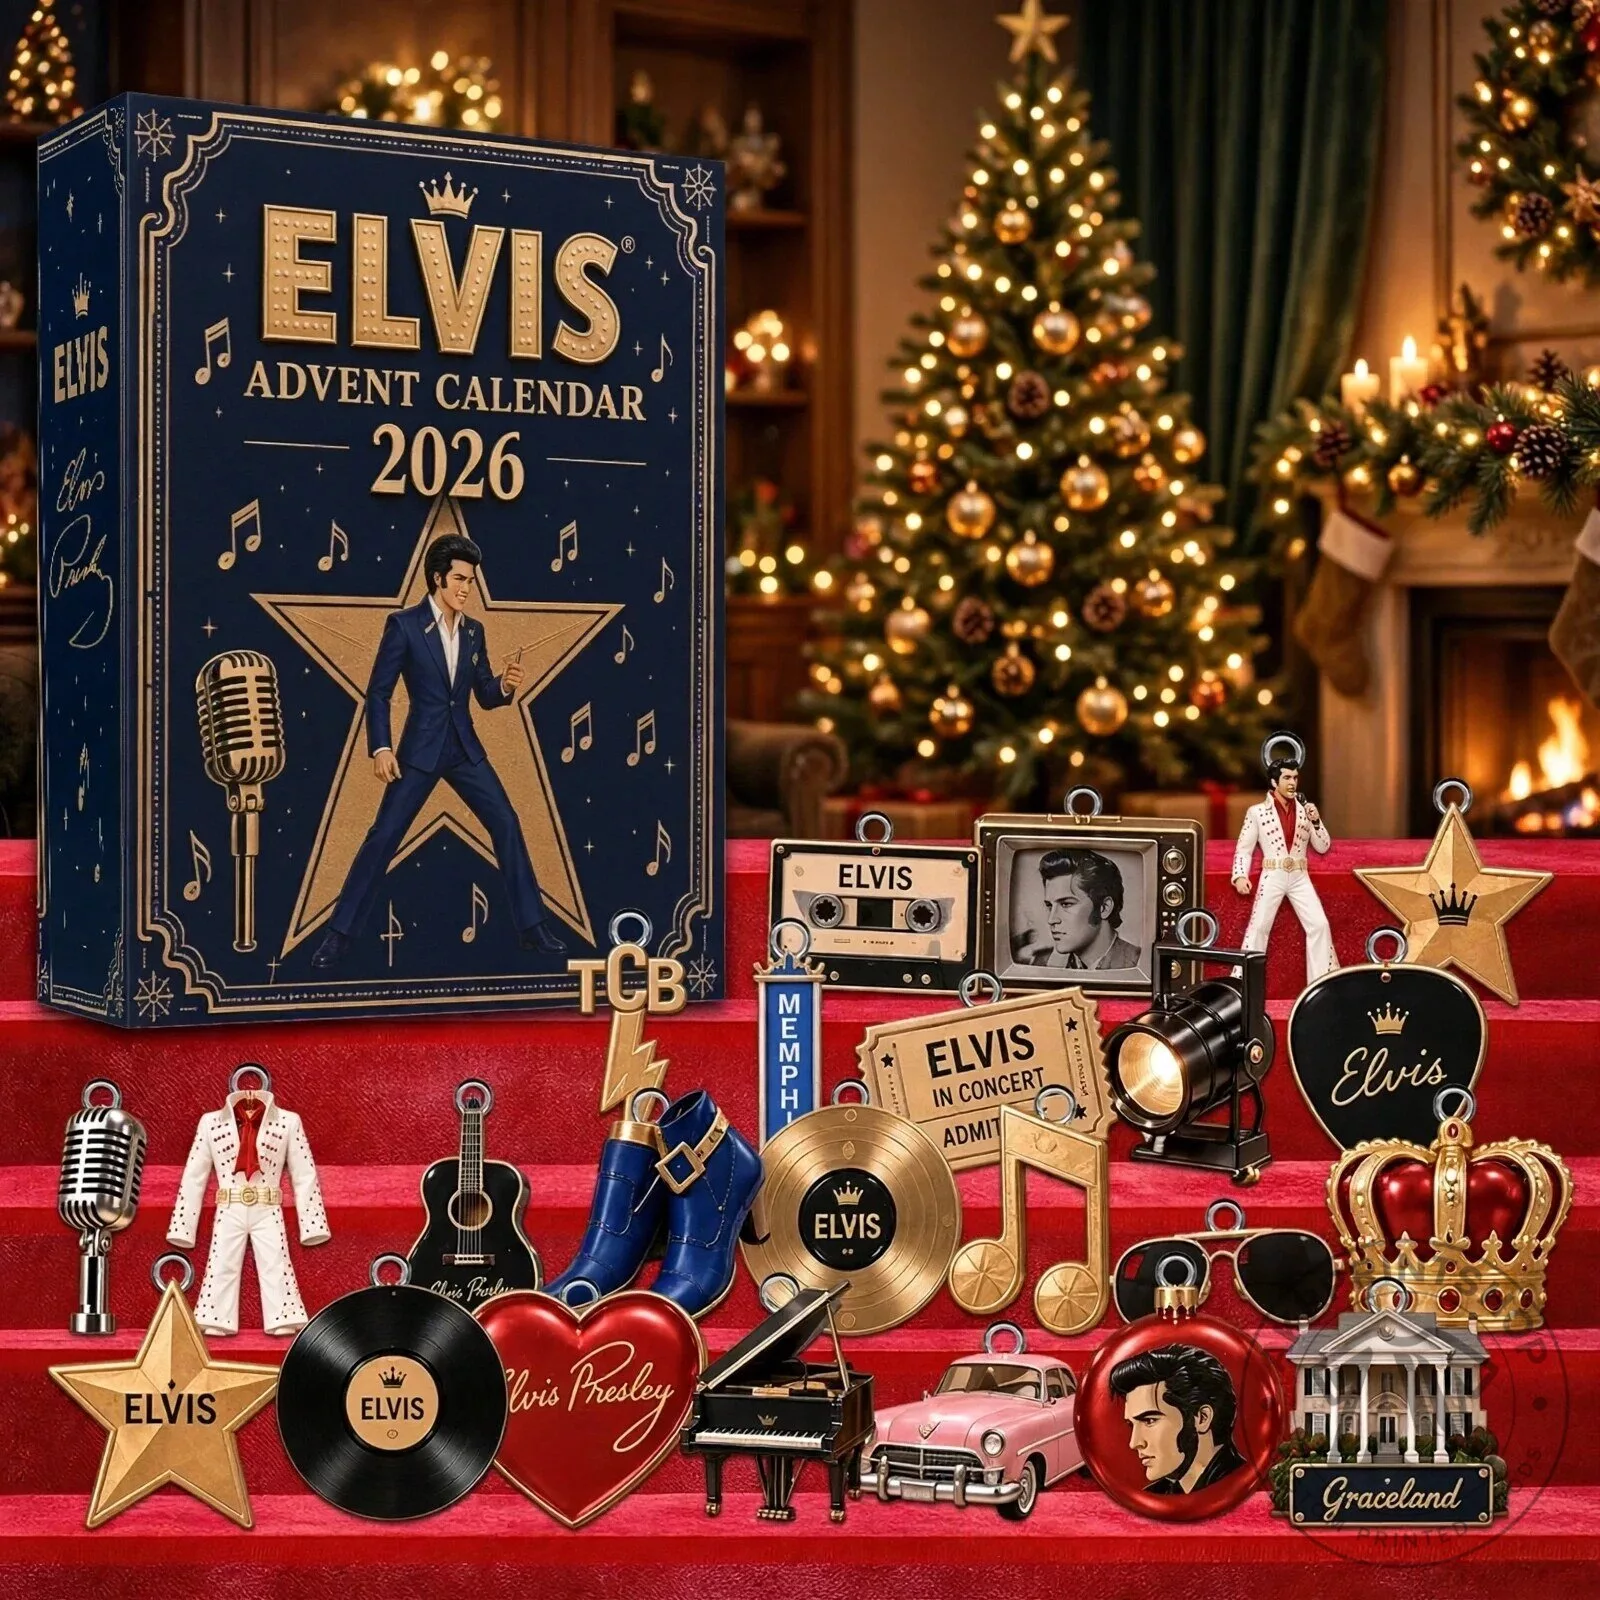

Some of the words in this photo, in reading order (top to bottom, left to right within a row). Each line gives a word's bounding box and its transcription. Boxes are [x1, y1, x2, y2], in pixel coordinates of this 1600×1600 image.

[54, 326, 109, 403] ELVIS
[243, 360, 420, 406] ADVENT
[435, 373, 647, 421] CALENDAR
[371, 423, 525, 500] 2026
[838, 864, 913, 891] ELVIS
[567, 943, 688, 1014] TCB
[926, 1024, 1035, 1079] ELVIS
[1331, 1047, 1447, 1106] Elvis
[932, 1088, 954, 1108] IN
[959, 1067, 1044, 1102] CONCERT
[943, 1117, 1000, 1148] ADMIT
[815, 1213, 881, 1239] ELVIS
[125, 1393, 217, 1424] ELVIS
[361, 1397, 424, 1420] ELVIS
[567, 1340, 675, 1452] Presley
[1323, 1476, 1465, 1521] Graceland
